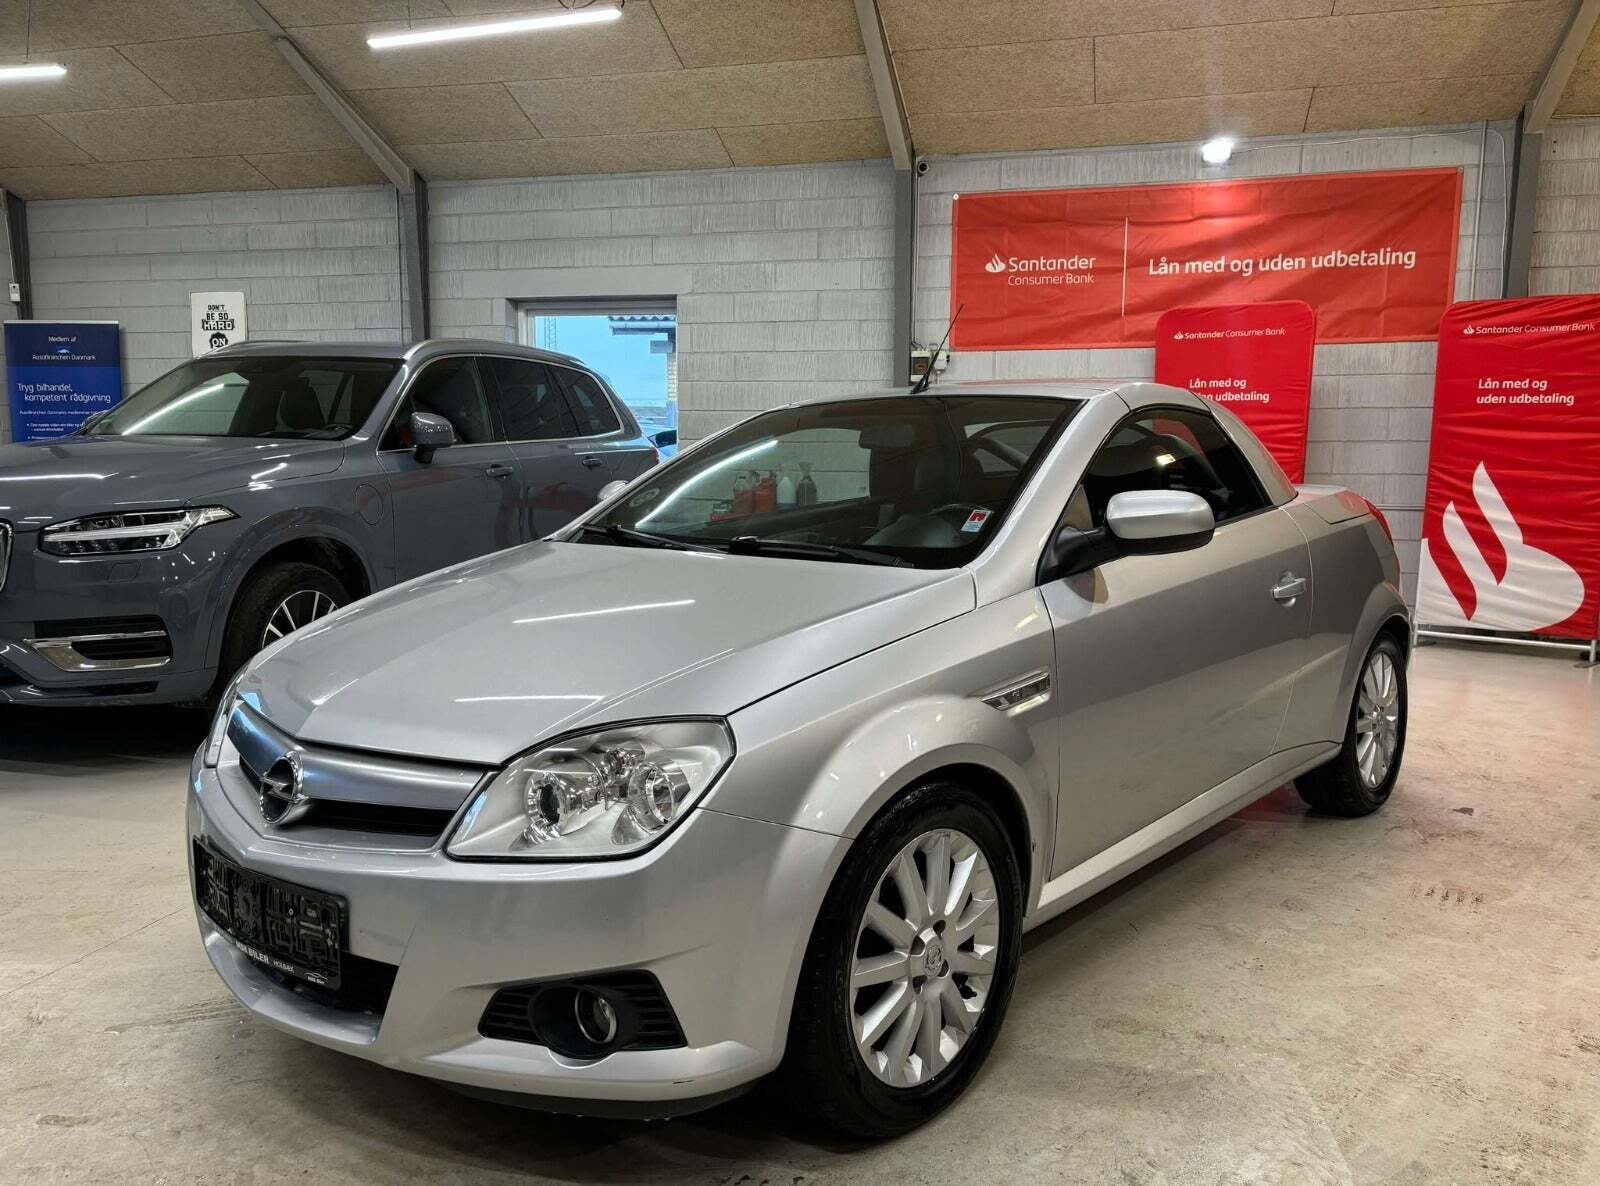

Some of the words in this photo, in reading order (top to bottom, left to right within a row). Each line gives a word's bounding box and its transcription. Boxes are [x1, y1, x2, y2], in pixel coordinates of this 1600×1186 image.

[1008, 256, 1096, 272] Santander
[1149, 256, 1180, 275] Lån
[1184, 256, 1225, 274] med
[1230, 260, 1253, 277] og
[1258, 254, 1306, 271] uden
[1311, 247, 1416, 269] udbetaling
[1007, 275, 1064, 286] Consumer
[1065, 272, 1094, 284] Bank
[206, 312, 216, 321] BE
[218, 312, 229, 321] SO
[203, 320, 234, 330] HARD
[1475, 325, 1523, 335] Santander
[1524, 323, 1571, 333] Consumer
[1571, 322, 1596, 331] Bank
[1184, 331, 1225, 339] Santander
[1225, 328, 1264, 337] Consumer
[1265, 327, 1286, 336] Bank
[211, 338, 226, 348] ON
[17, 383, 34, 393] Tryg
[36, 383, 73, 392] bilhandel,
[1189, 378, 1207, 389] Lån
[1208, 378, 1232, 388] med
[1233, 379, 1247, 390] og
[1478, 378, 1499, 389] Lån
[1502, 379, 1530, 389] med
[1531, 380, 1548, 391] og
[24, 393, 67, 403] kompetent
[69, 393, 111, 403] rådgivning
[1215, 391, 1270, 403] udbetaling
[1476, 394, 1506, 404] uden
[1508, 392, 1575, 406] udbetaling
